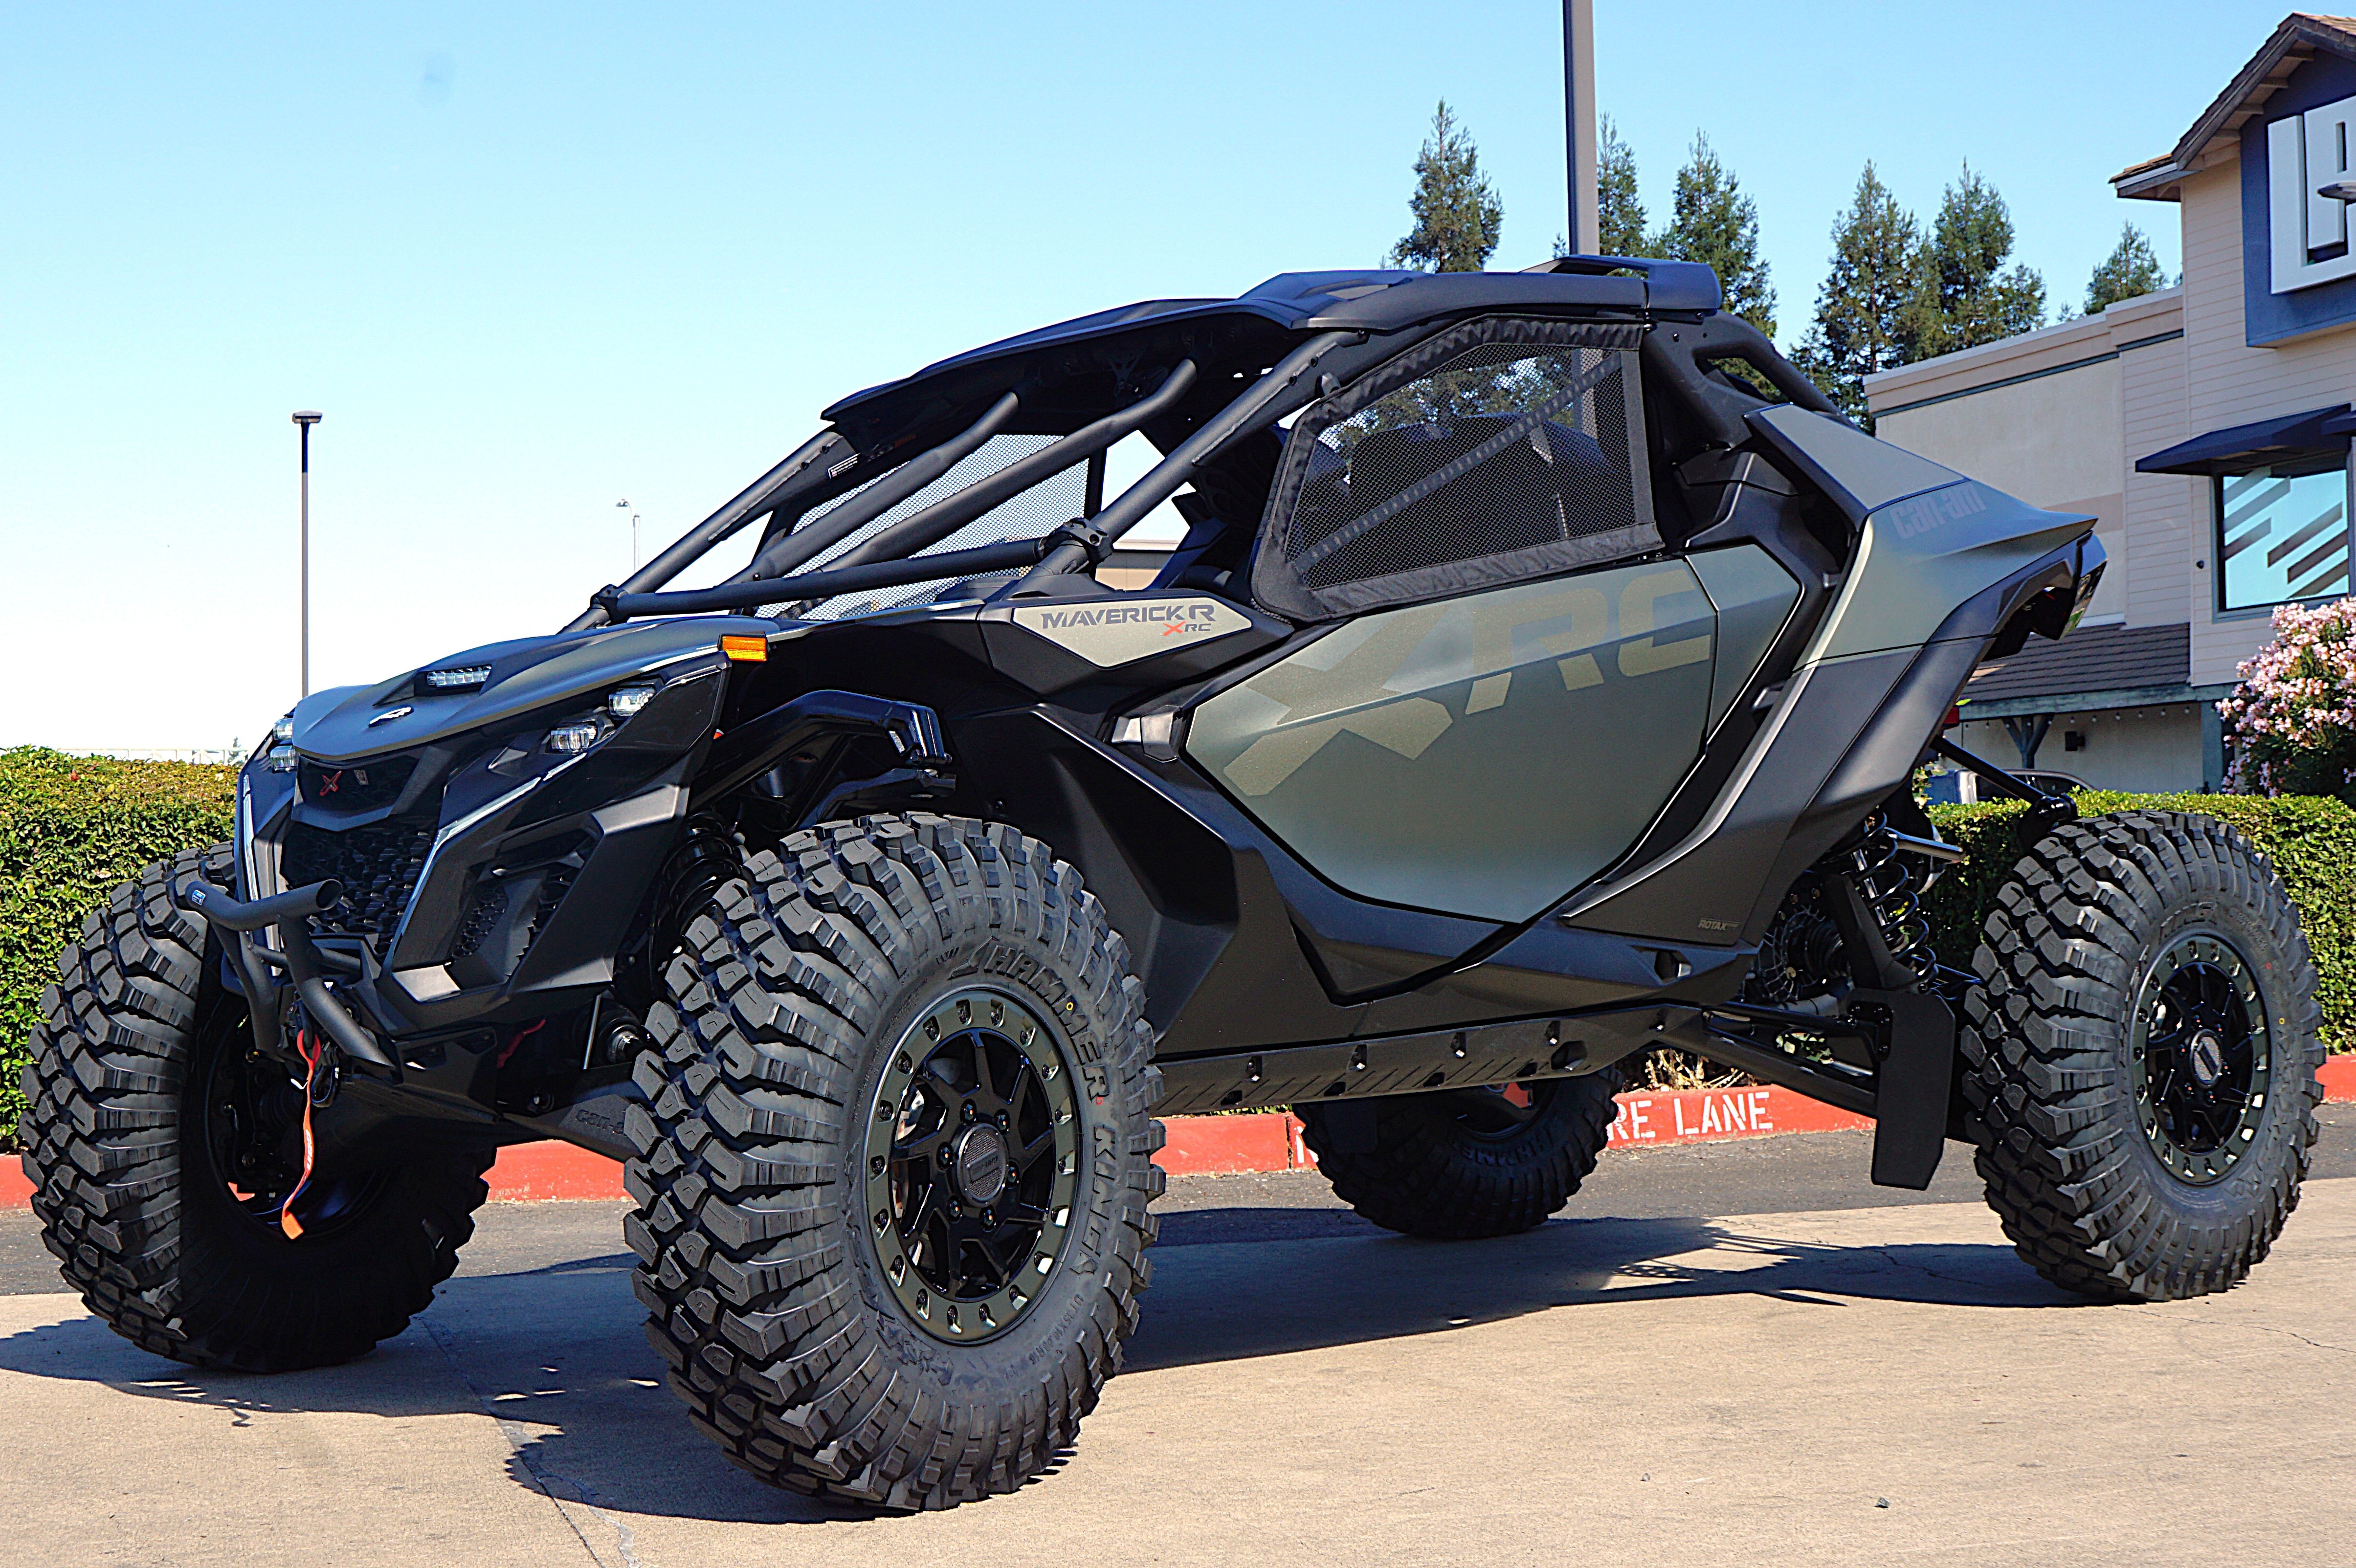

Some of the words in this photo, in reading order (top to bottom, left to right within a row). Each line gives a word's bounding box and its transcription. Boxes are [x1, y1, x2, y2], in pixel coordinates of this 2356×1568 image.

[1040, 605, 1185, 629] MAVERICK
[1188, 604, 1216, 622] R
[1162, 621, 1212, 636] XRC
[1223, 568, 1711, 797] XRC
[1697, 919, 1728, 931] ROTAX
[983, 945, 1110, 1101] HAMMER
[1082, 1126, 1117, 1257] KING
[1605, 1099, 1656, 1141] RE
[1673, 1091, 1773, 1135] LANE
